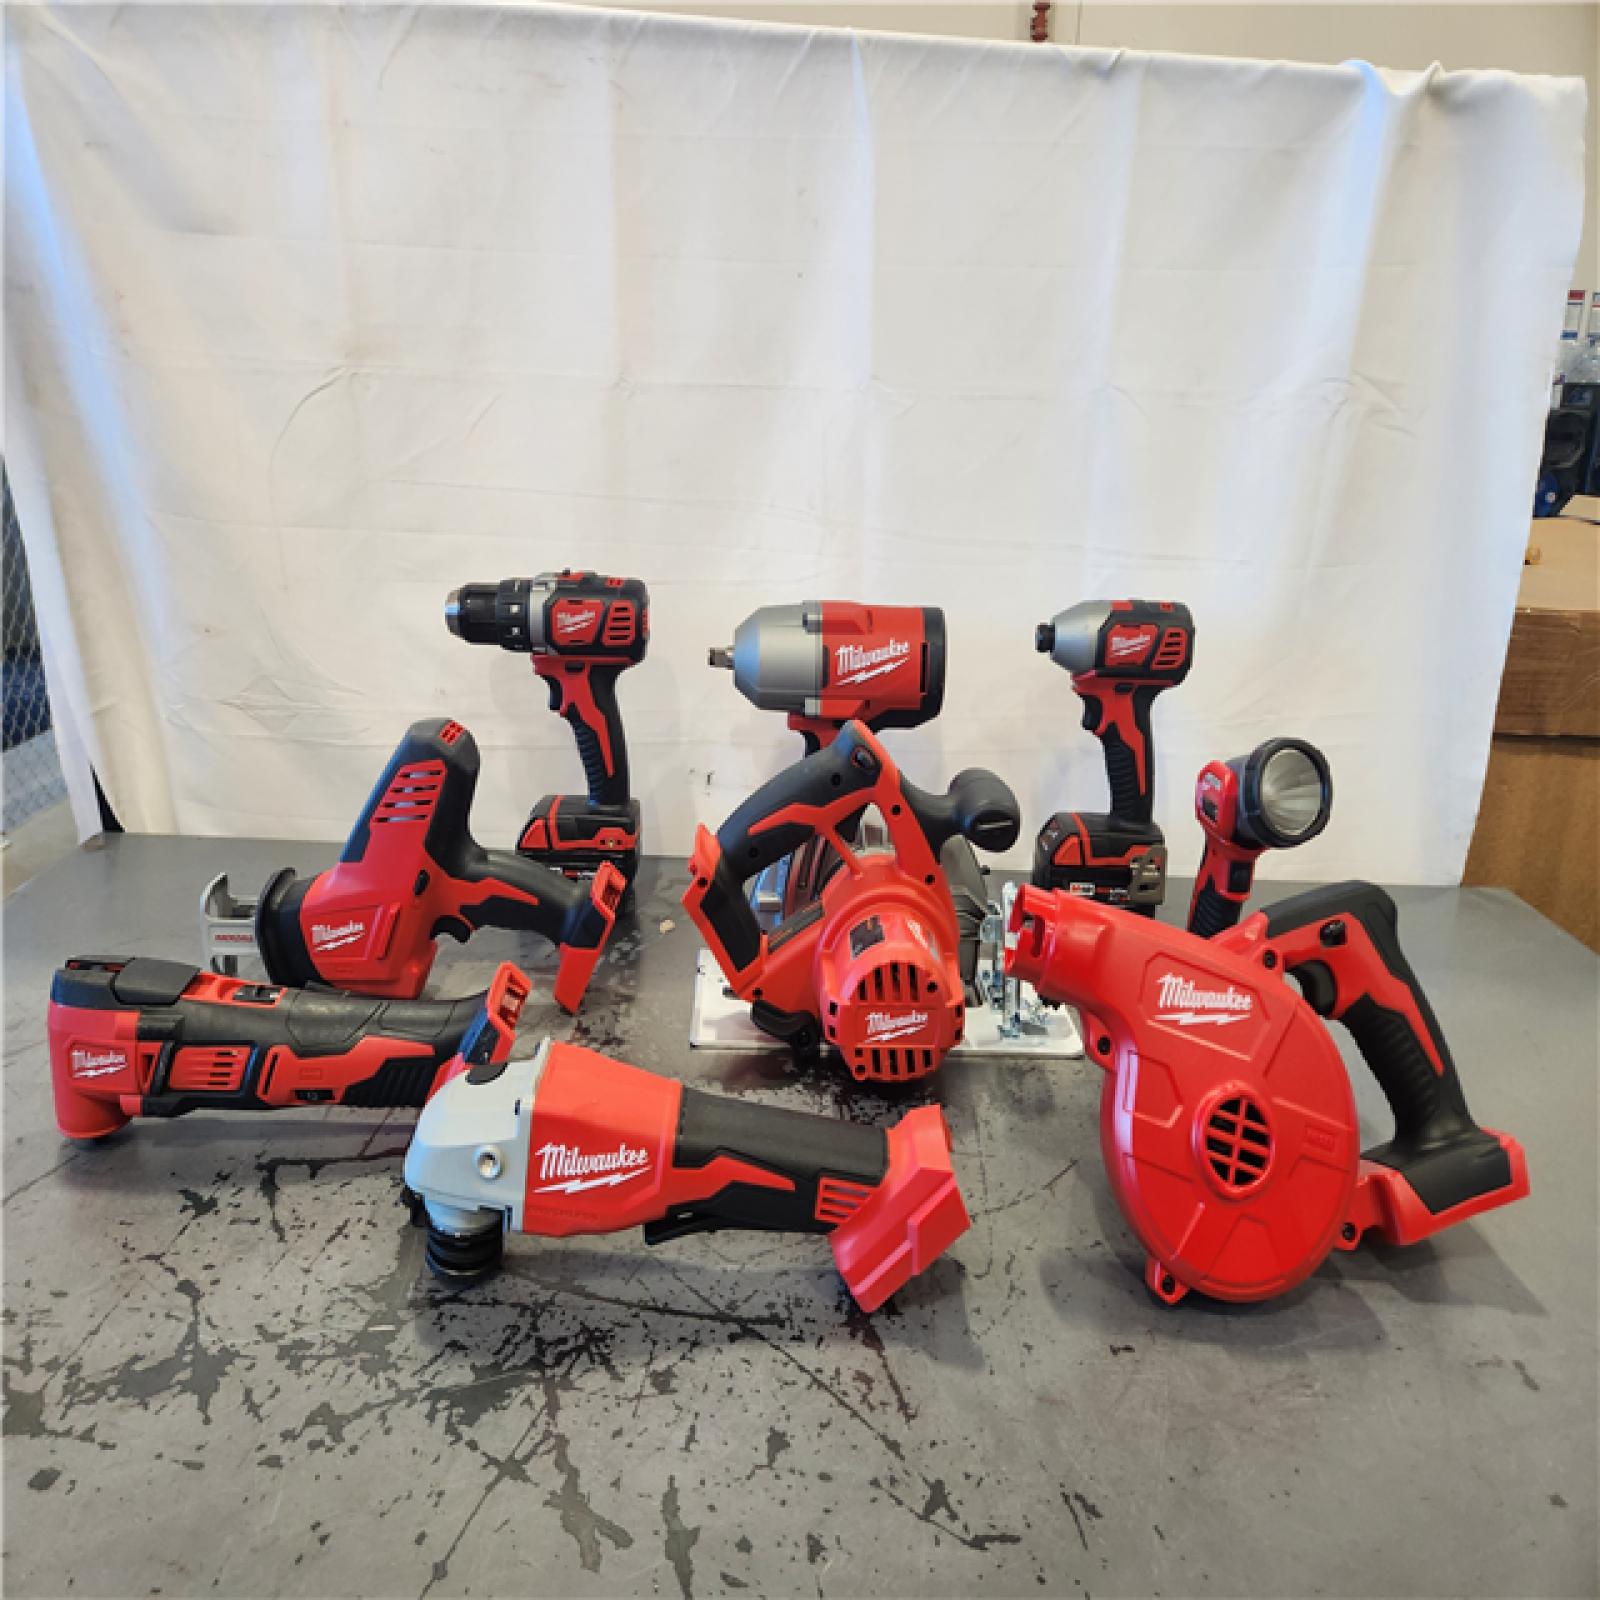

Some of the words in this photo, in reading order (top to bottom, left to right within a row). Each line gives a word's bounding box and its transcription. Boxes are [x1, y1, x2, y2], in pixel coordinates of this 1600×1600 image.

[835, 637, 910, 676] Milwaukee
[1157, 972, 1251, 1010] Milwaukee
[535, 1142, 648, 1180] Milwaukee
